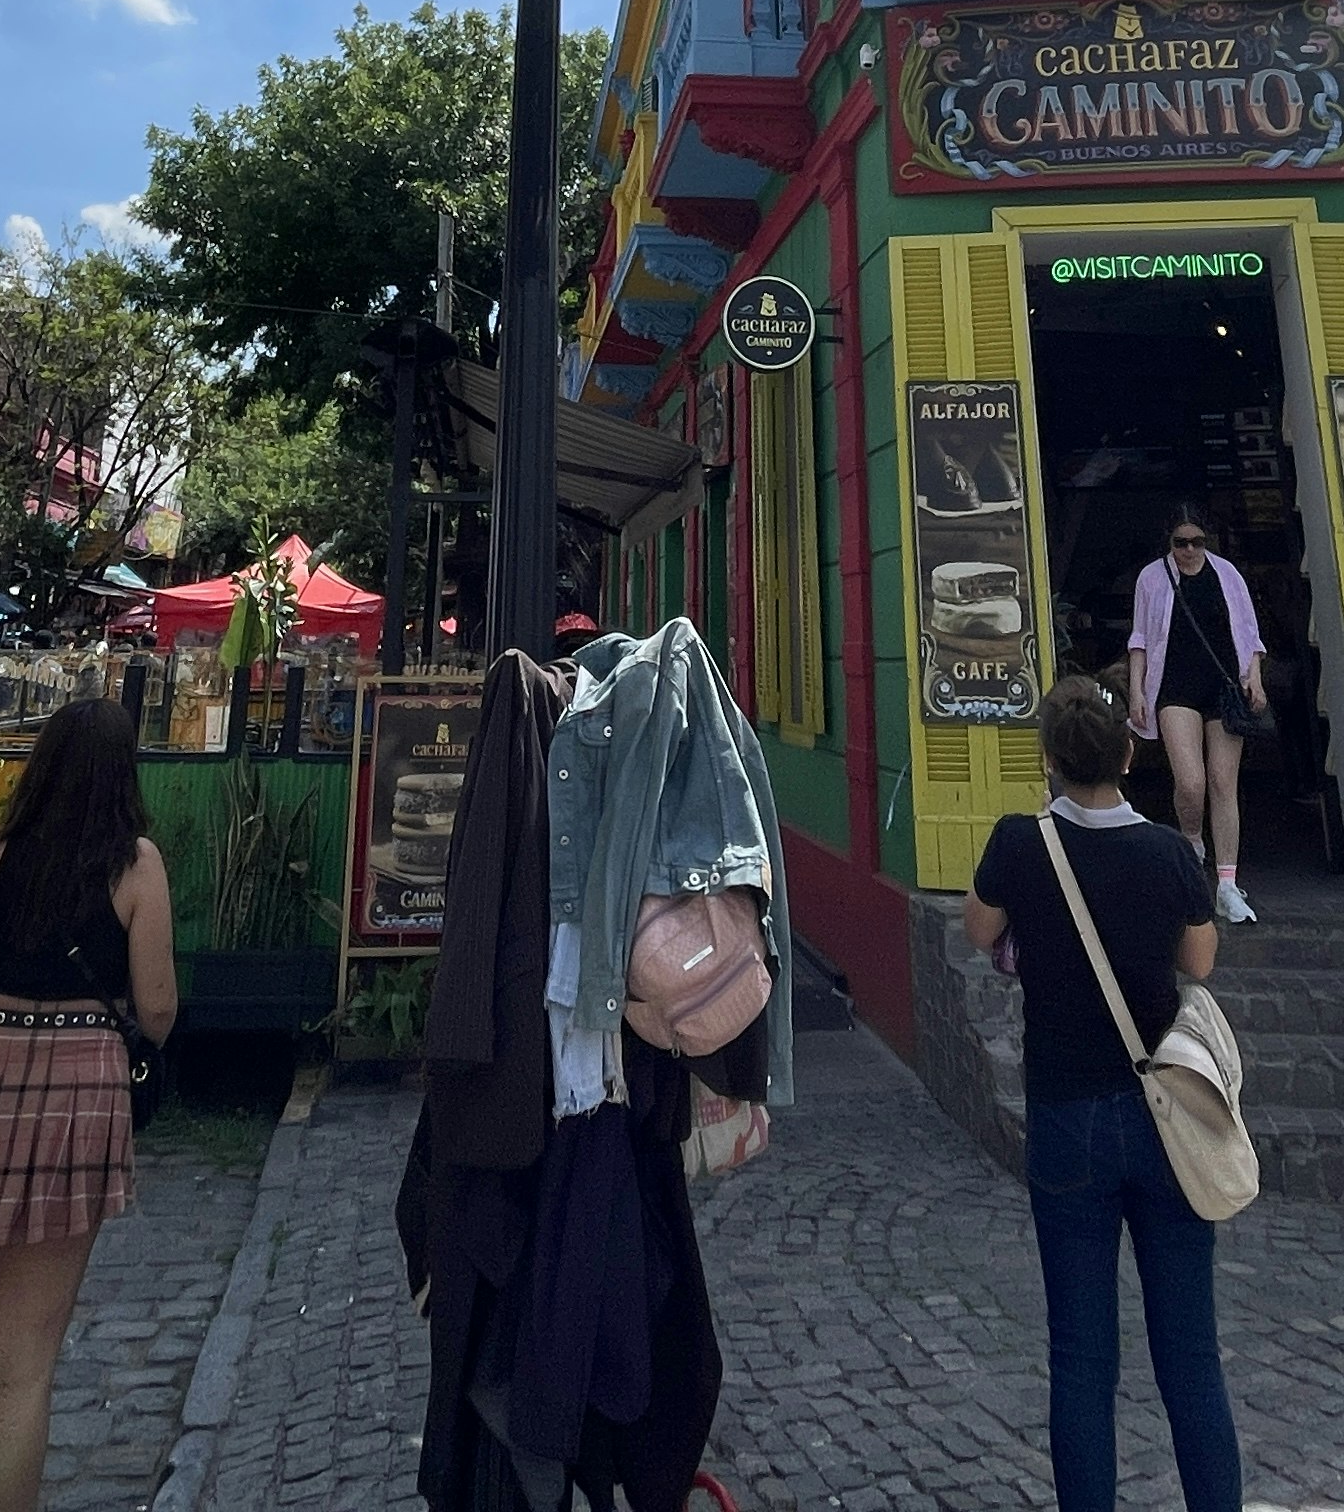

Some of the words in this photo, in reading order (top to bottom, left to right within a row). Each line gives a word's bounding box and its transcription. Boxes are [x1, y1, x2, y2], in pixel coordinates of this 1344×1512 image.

[979, 68, 1304, 148] CAMINITO
[1061, 144, 1151, 160] BUENOS
[1160, 142, 1228, 157] AIRES
[1051, 252, 1264, 283] @VISITCAMINITO
[746, 335, 792, 348] CAMINITO
[919, 402, 1011, 420] ALFAJOR
[953, 661, 1009, 681] CAFE
[400, 890, 446, 908] CAMIN
